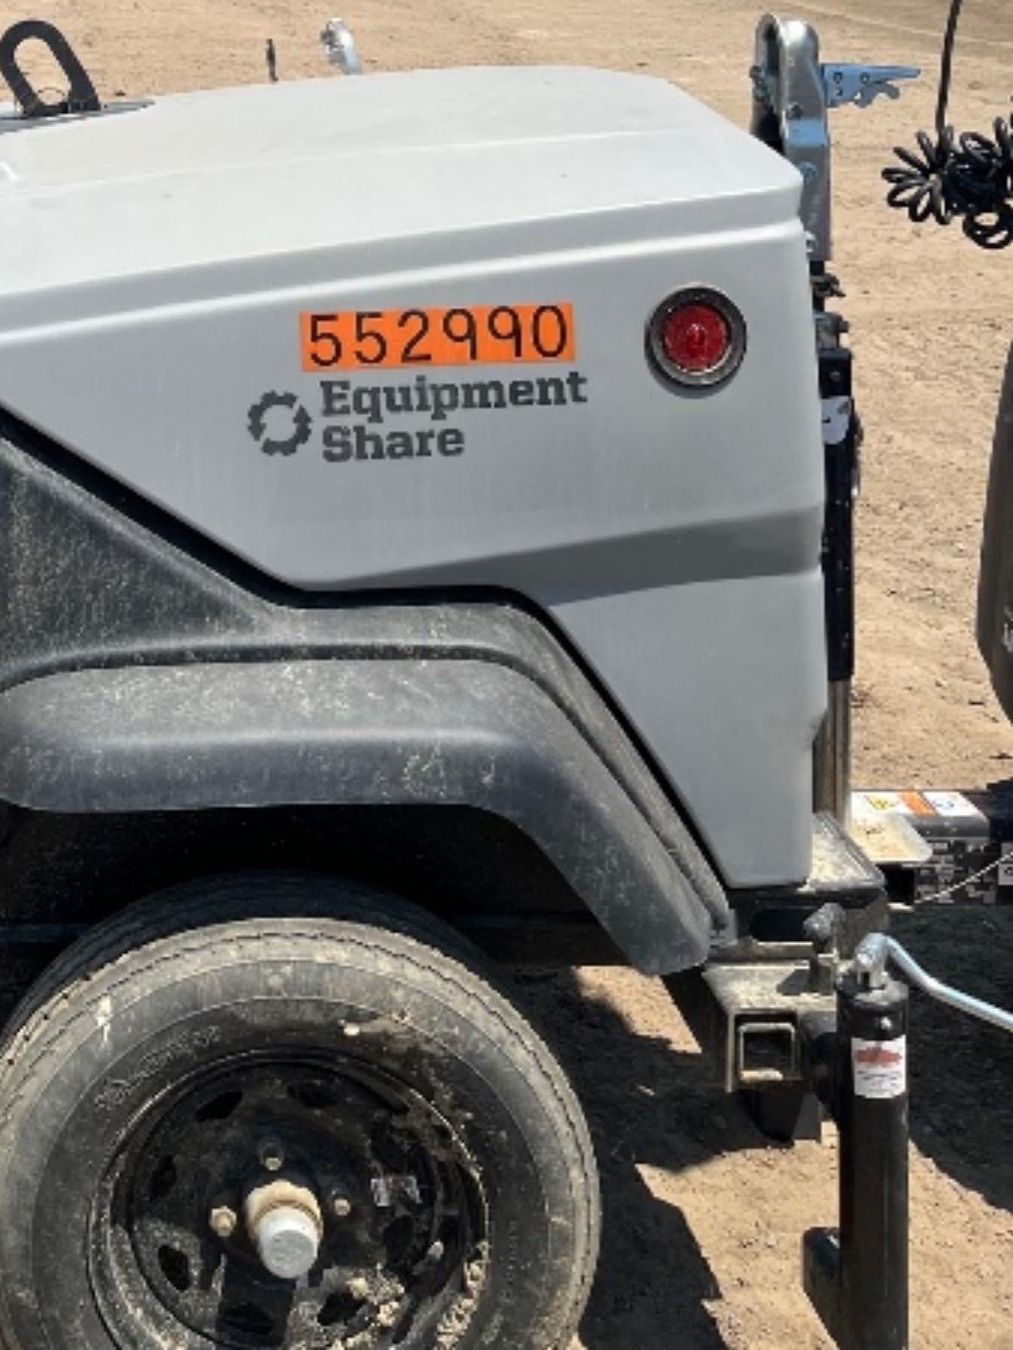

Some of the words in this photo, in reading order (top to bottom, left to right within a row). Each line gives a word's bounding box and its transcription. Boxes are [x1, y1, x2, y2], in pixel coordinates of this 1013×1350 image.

[309, 305, 568, 367] 552990
[319, 371, 588, 422] Equipment
[322, 425, 465, 463] Share
